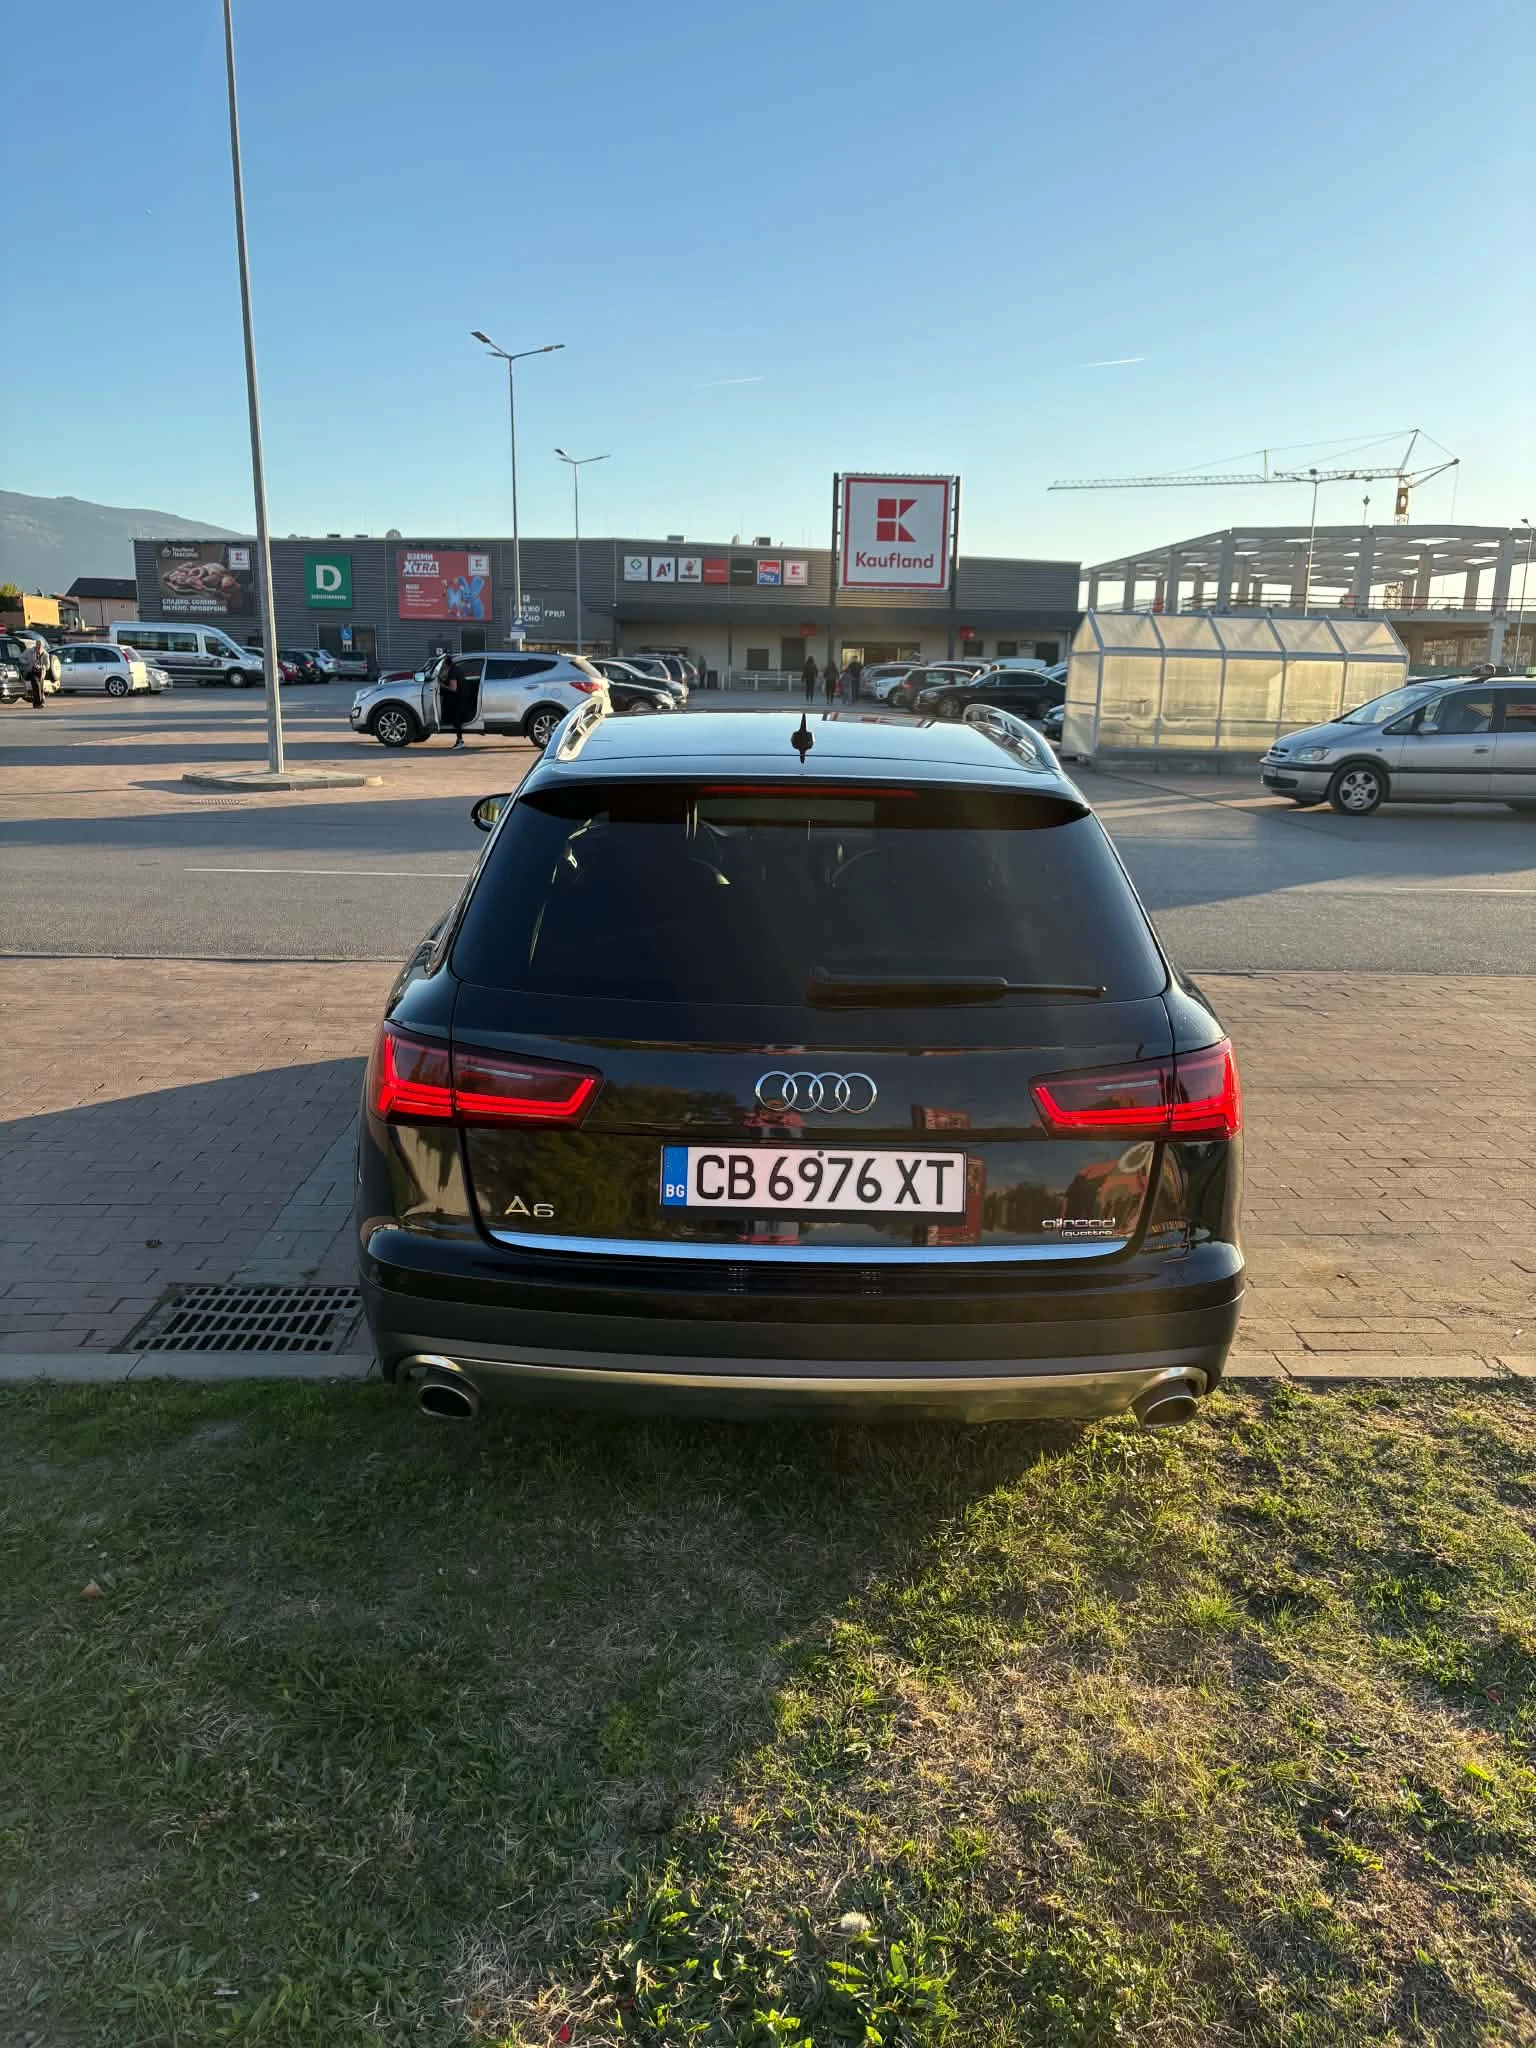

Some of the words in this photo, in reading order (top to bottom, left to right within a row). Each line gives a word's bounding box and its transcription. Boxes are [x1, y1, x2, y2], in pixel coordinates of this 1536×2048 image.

[855, 551, 934, 569] Kaufland
[656, 562, 671, 577] A1
[315, 564, 342, 591] D
[544, 609, 566, 618] ГРИЛ
[696, 1154, 756, 1200] CB
[768, 1156, 882, 1203] 6976
[894, 1159, 955, 1205] XT
[666, 1183, 685, 1198] BG
[504, 1195, 555, 1217] A6
[1041, 1217, 1116, 1229] allroad
[1064, 1230, 1113, 1238] quattro
